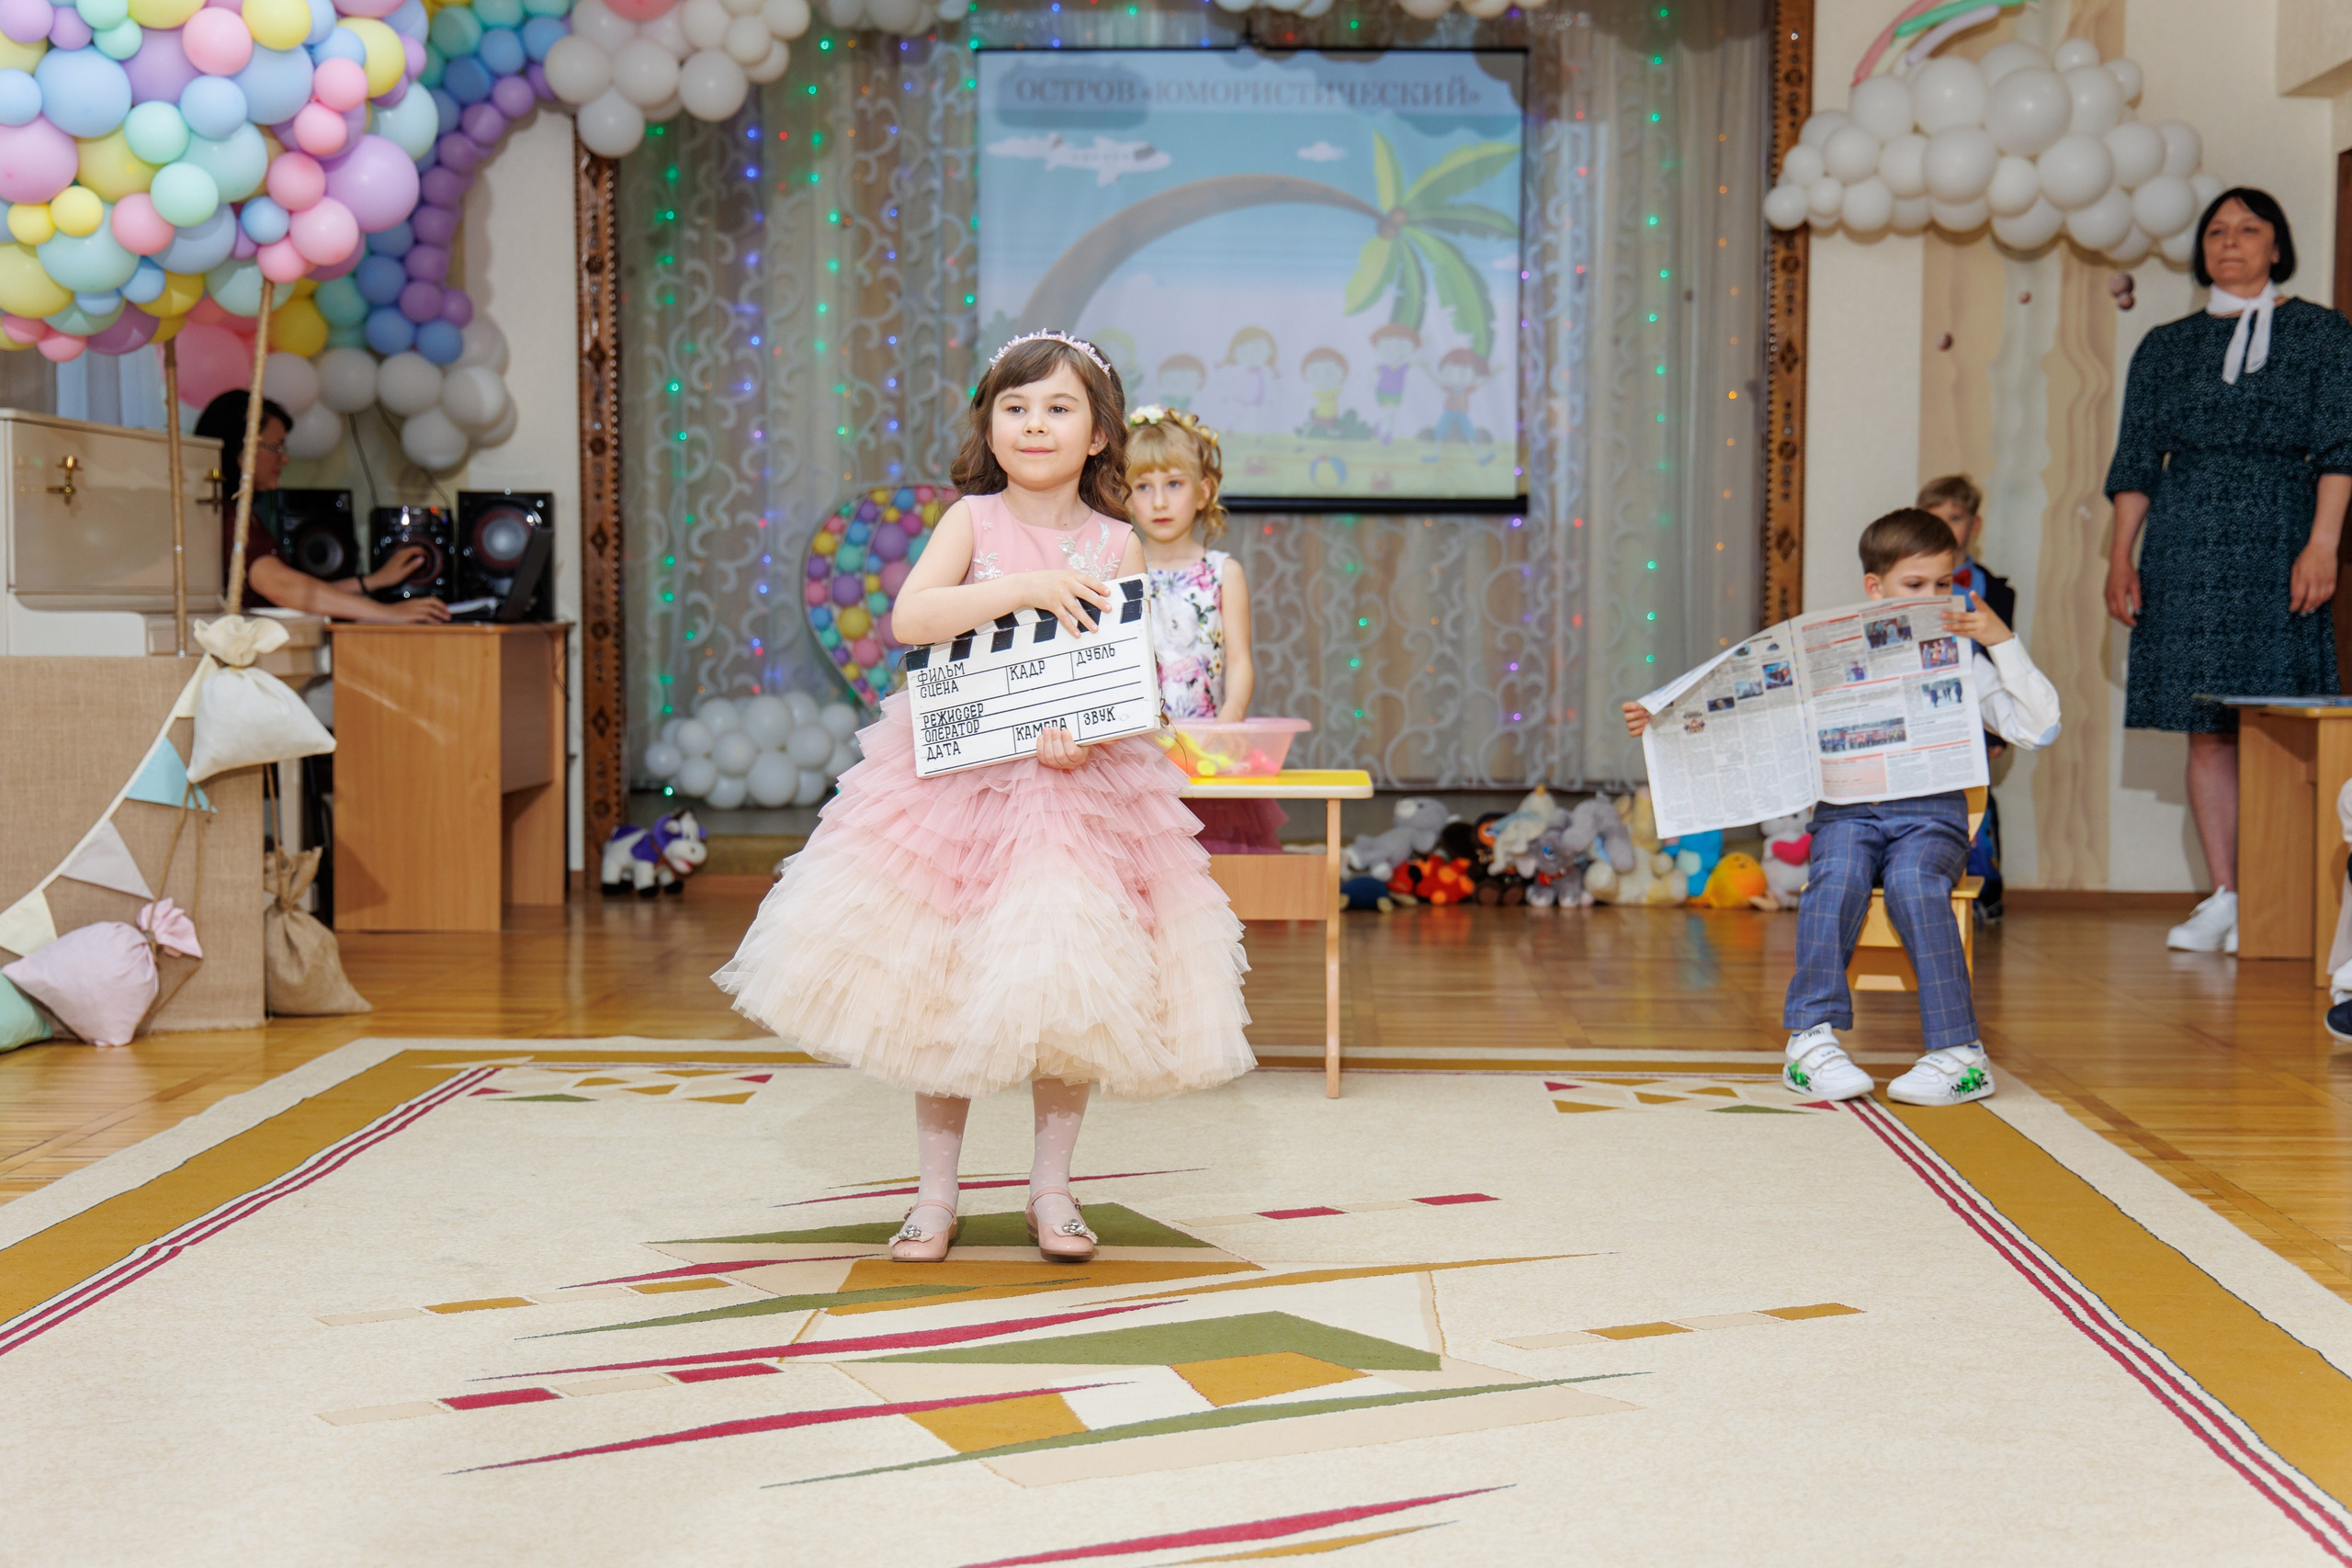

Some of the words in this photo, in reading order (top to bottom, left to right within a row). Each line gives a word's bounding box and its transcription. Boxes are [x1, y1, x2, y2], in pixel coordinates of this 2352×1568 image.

[1015, 78, 1136, 104] ОСТРОВ
[1077, 644, 1115, 667] ДУБЛЬ
[917, 661, 965, 685] ФИЛЬМ
[1009, 660, 1046, 681] КАДР
[920, 679, 959, 698] СЦЕНА
[922, 703, 984, 728] РЕЖИССЕР
[1083, 706, 1115, 726] ЗВУК
[924, 719, 980, 742] ОПЕРАТОР
[926, 740, 962, 761] ДАТА
